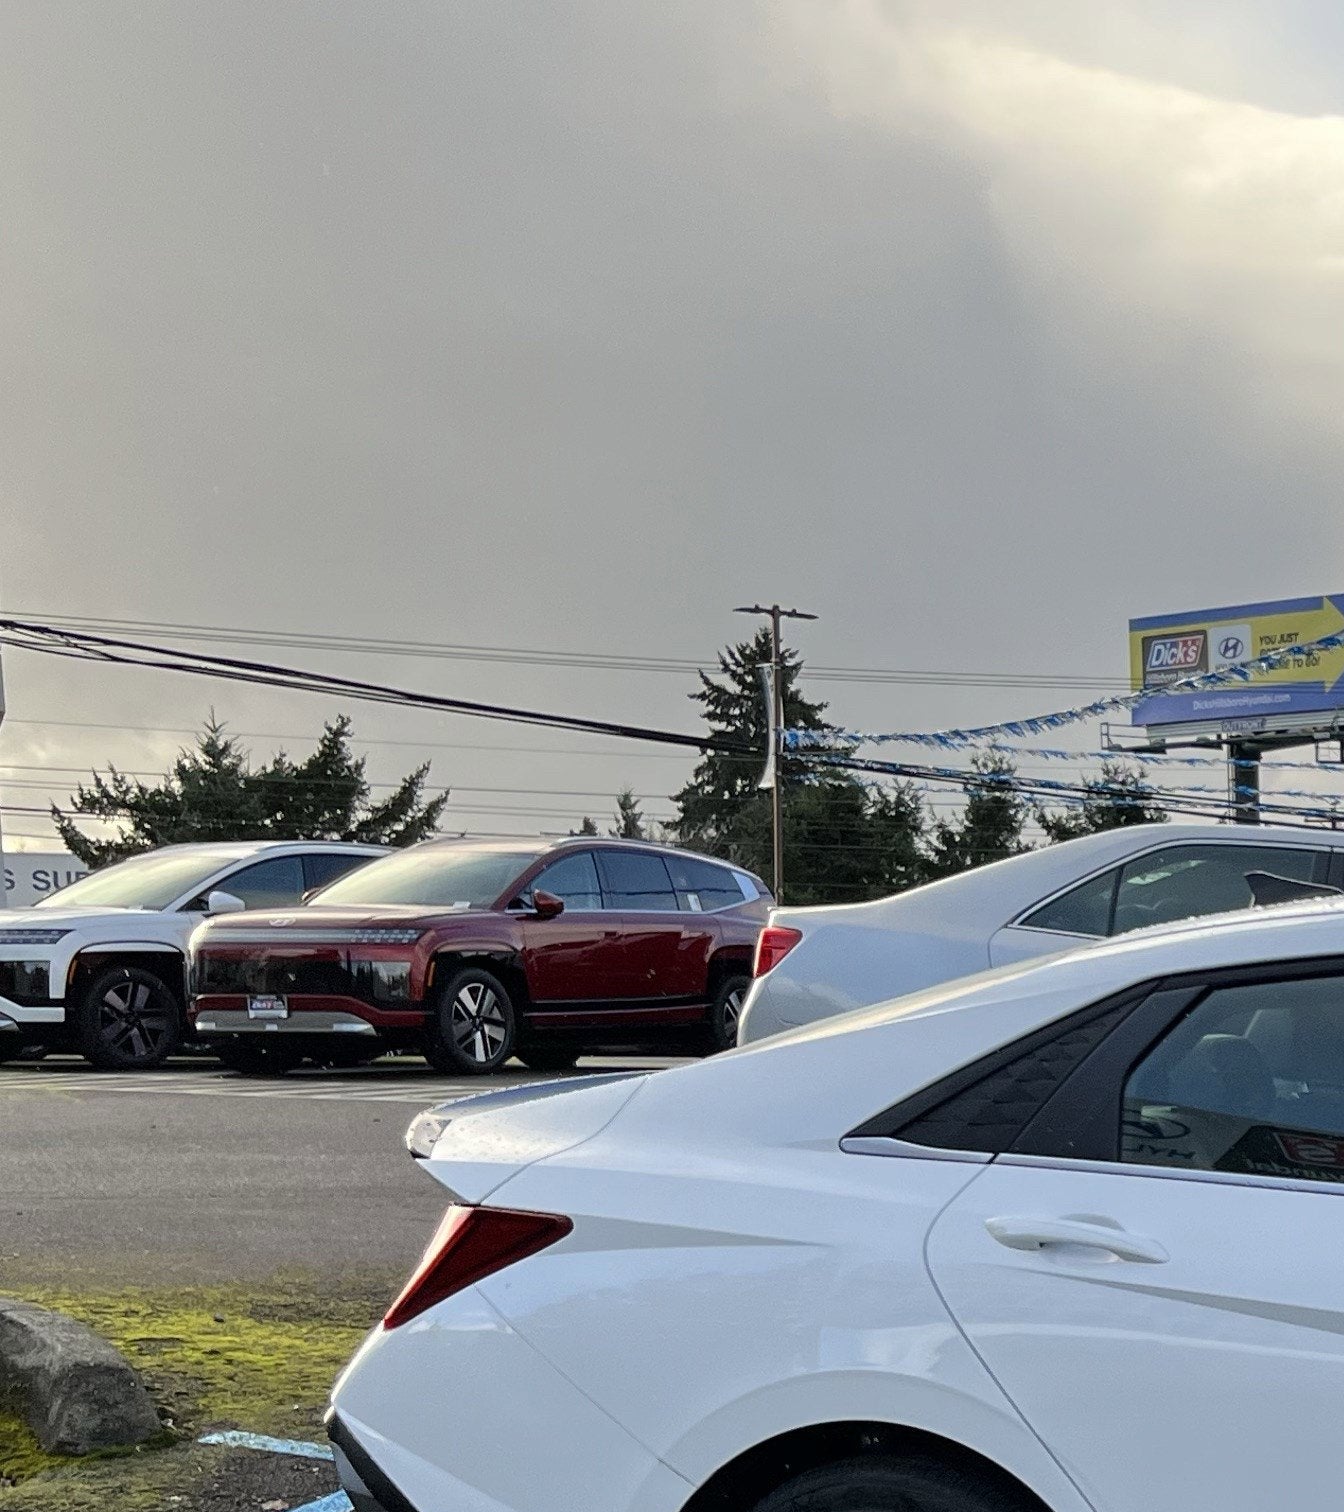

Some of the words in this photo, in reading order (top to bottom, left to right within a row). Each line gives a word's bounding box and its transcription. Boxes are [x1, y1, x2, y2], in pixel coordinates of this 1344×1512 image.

[1259, 635, 1276, 645] YOU
[1278, 632, 1299, 644] JUST
[1151, 641, 1197, 666] Dick's
